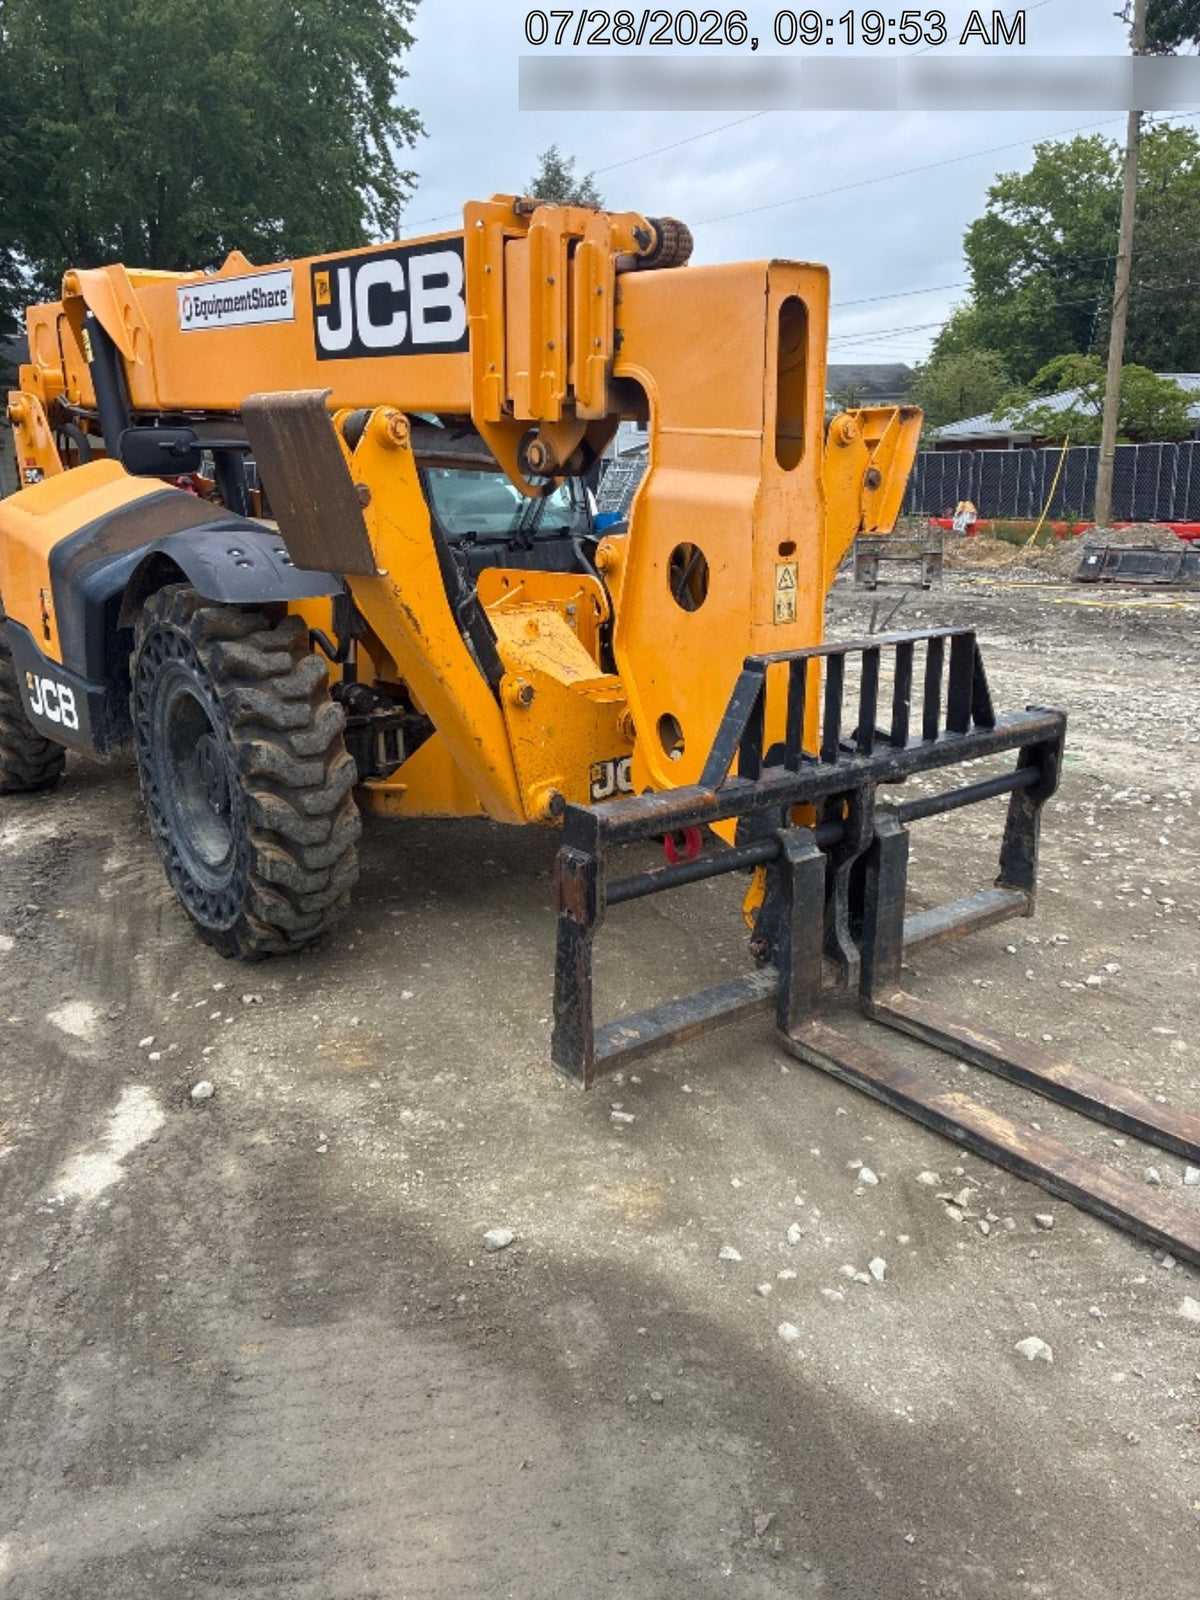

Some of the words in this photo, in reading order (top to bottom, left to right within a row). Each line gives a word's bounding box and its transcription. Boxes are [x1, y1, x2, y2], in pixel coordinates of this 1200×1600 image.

[193, 287, 287, 321] EquipmentShare
[317, 250, 467, 351] JCB
[29, 674, 79, 732] JCB
